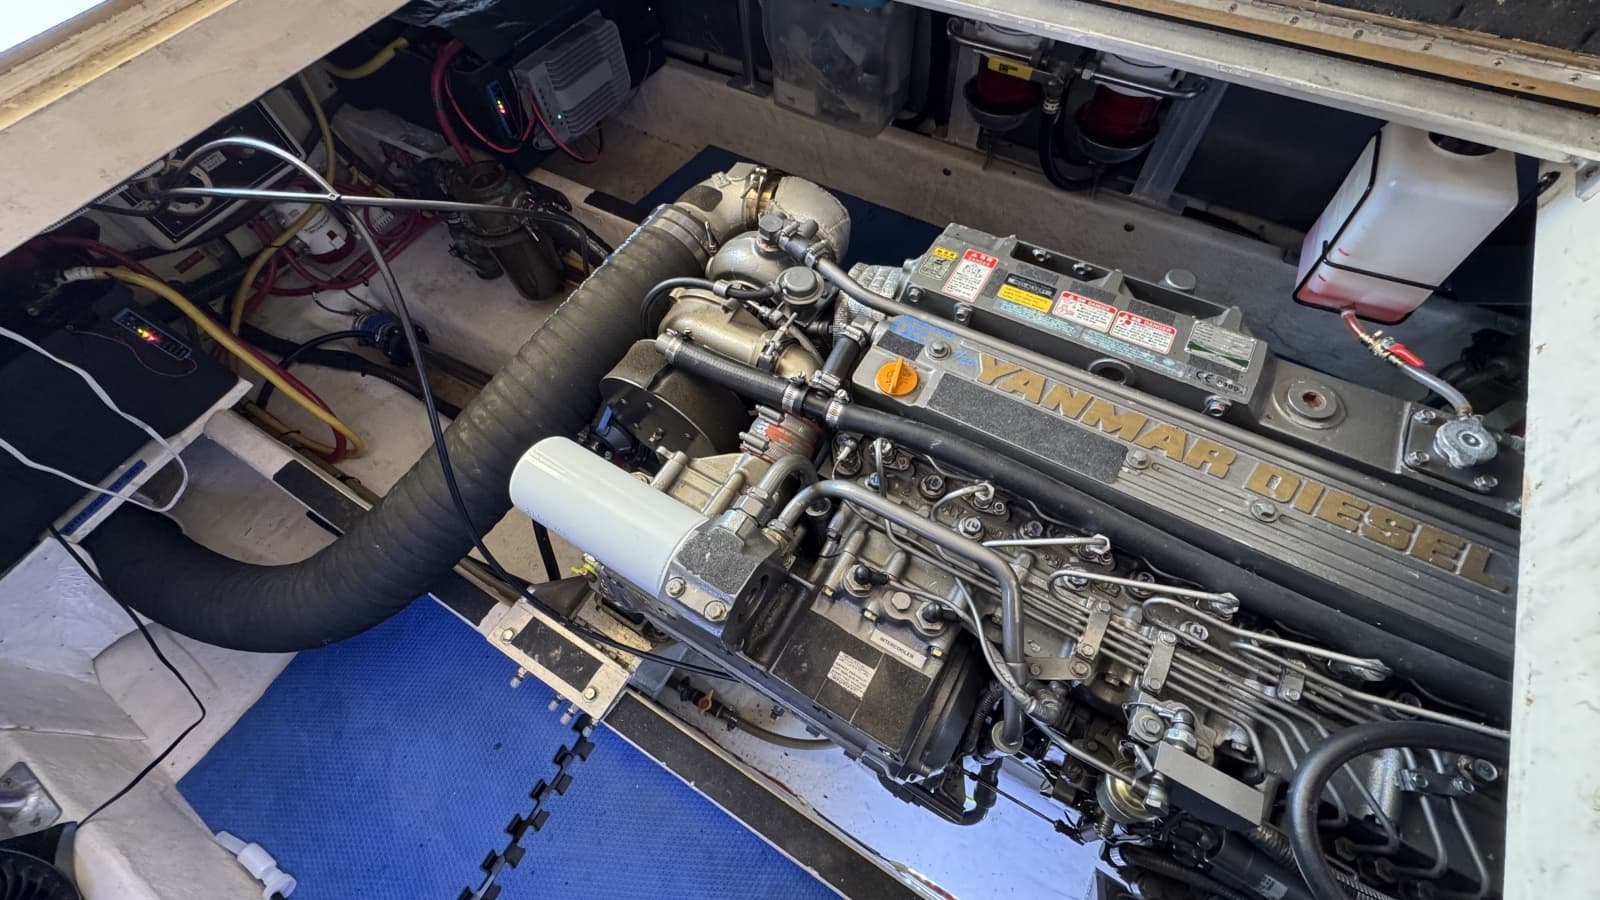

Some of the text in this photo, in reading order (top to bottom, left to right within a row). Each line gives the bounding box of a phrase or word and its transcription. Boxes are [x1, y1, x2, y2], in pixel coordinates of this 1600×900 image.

[1144, 319, 1173, 333] DANGER
[977, 353, 1510, 593] YANMAR DIESEL
[879, 637, 914, 659] INTERCOOLER
